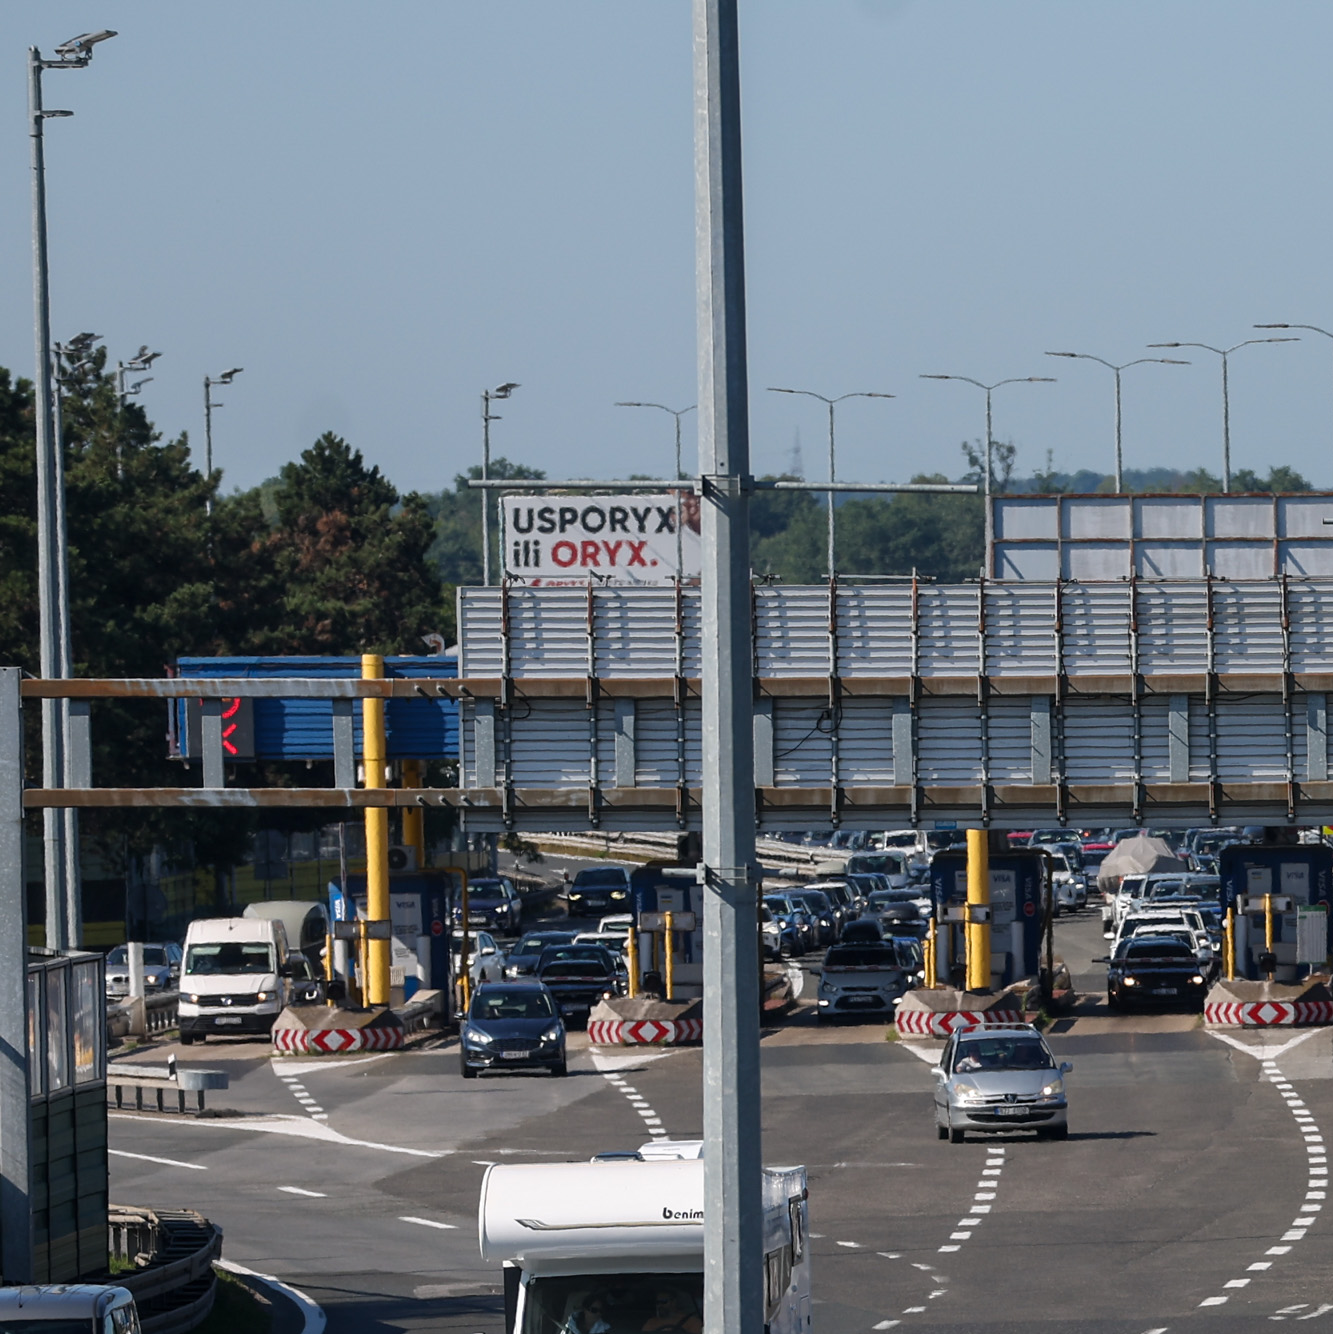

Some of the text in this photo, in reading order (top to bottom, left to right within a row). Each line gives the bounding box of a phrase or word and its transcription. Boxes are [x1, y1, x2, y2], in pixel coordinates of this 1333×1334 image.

[513, 505, 676, 534] USPORYX
[513, 540, 658, 567] ili ORYX.
[662, 1207, 704, 1219] benim
